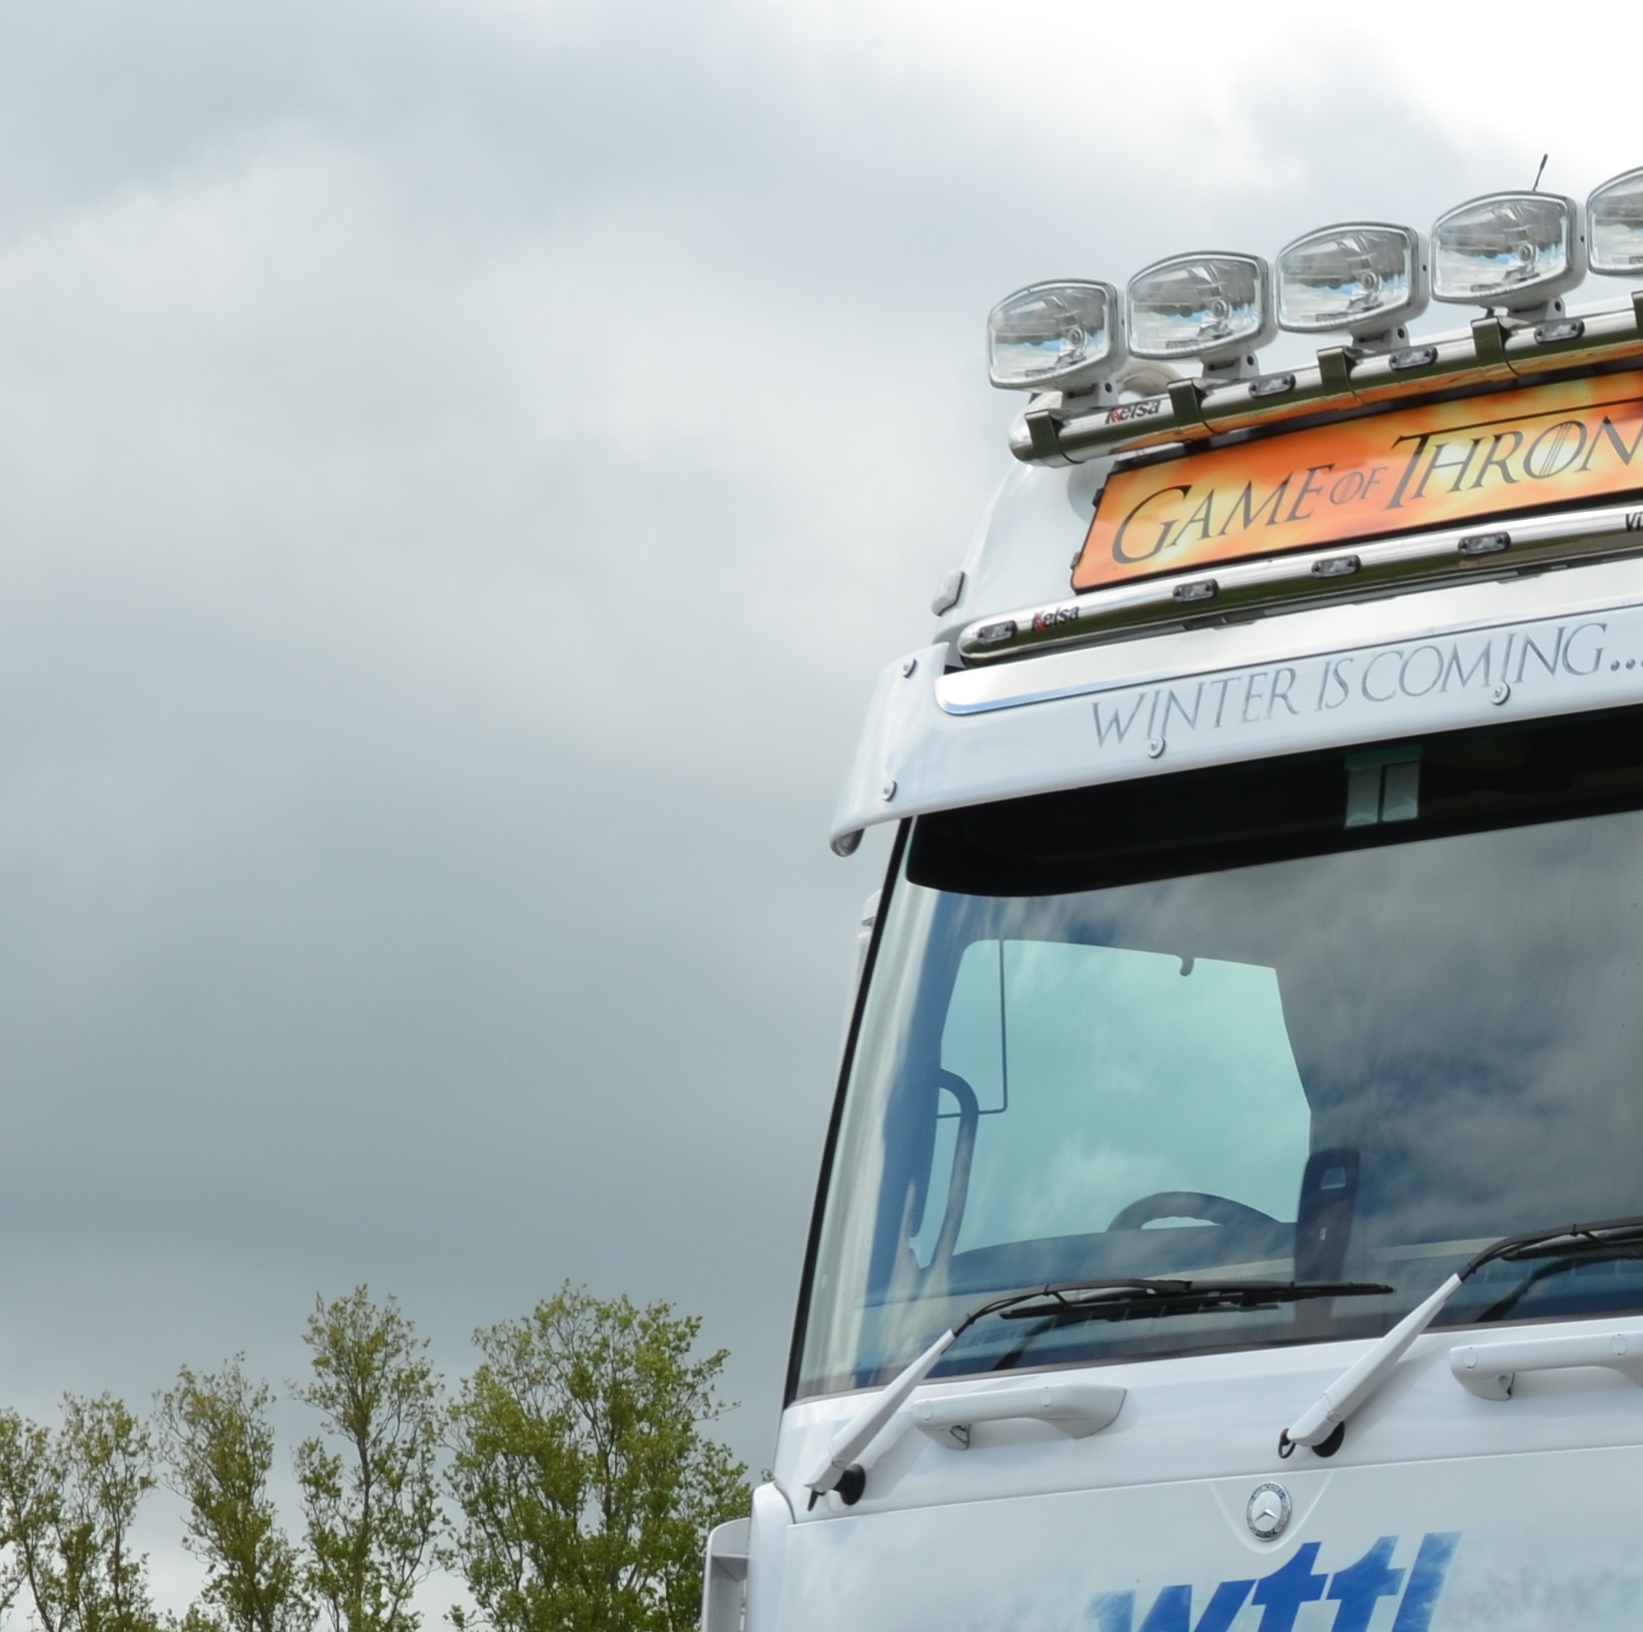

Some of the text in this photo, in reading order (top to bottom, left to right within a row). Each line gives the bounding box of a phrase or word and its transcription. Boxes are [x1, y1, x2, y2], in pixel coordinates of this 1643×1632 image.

[1112, 464, 1334, 563] GAME
[1330, 465, 1385, 506] OF
[1091, 667, 1297, 748] WINTER
[1314, 658, 1354, 711] IS
